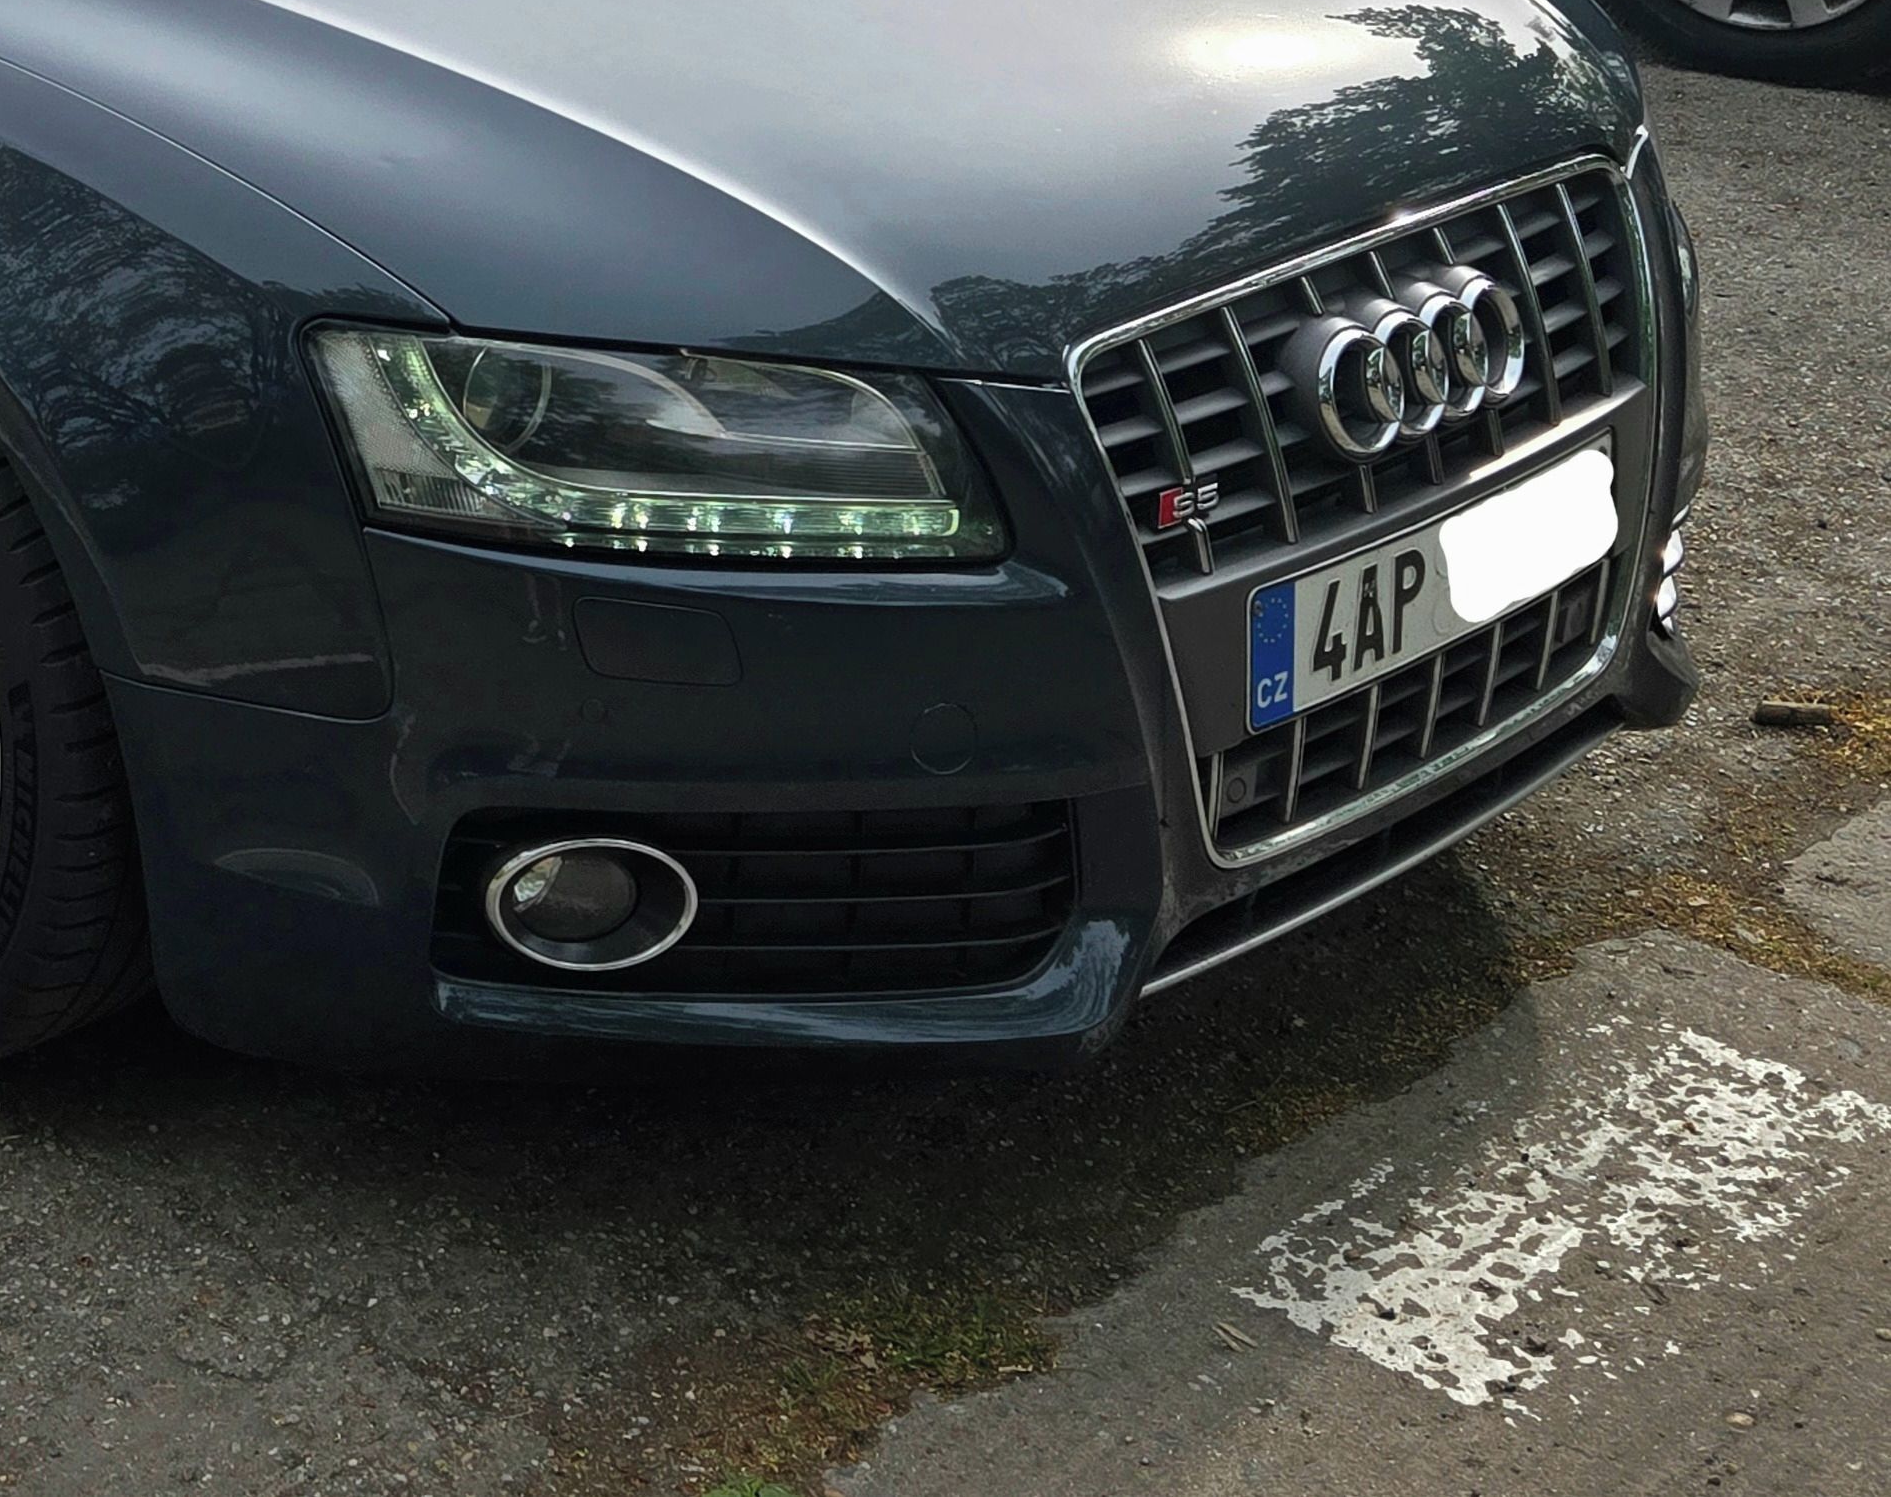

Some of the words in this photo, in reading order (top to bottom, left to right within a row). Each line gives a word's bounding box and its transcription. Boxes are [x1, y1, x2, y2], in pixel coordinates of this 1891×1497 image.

[1173, 482, 1219, 519] S5
[1313, 549, 1426, 682] 4AP
[1257, 671, 1288, 708] CZ
